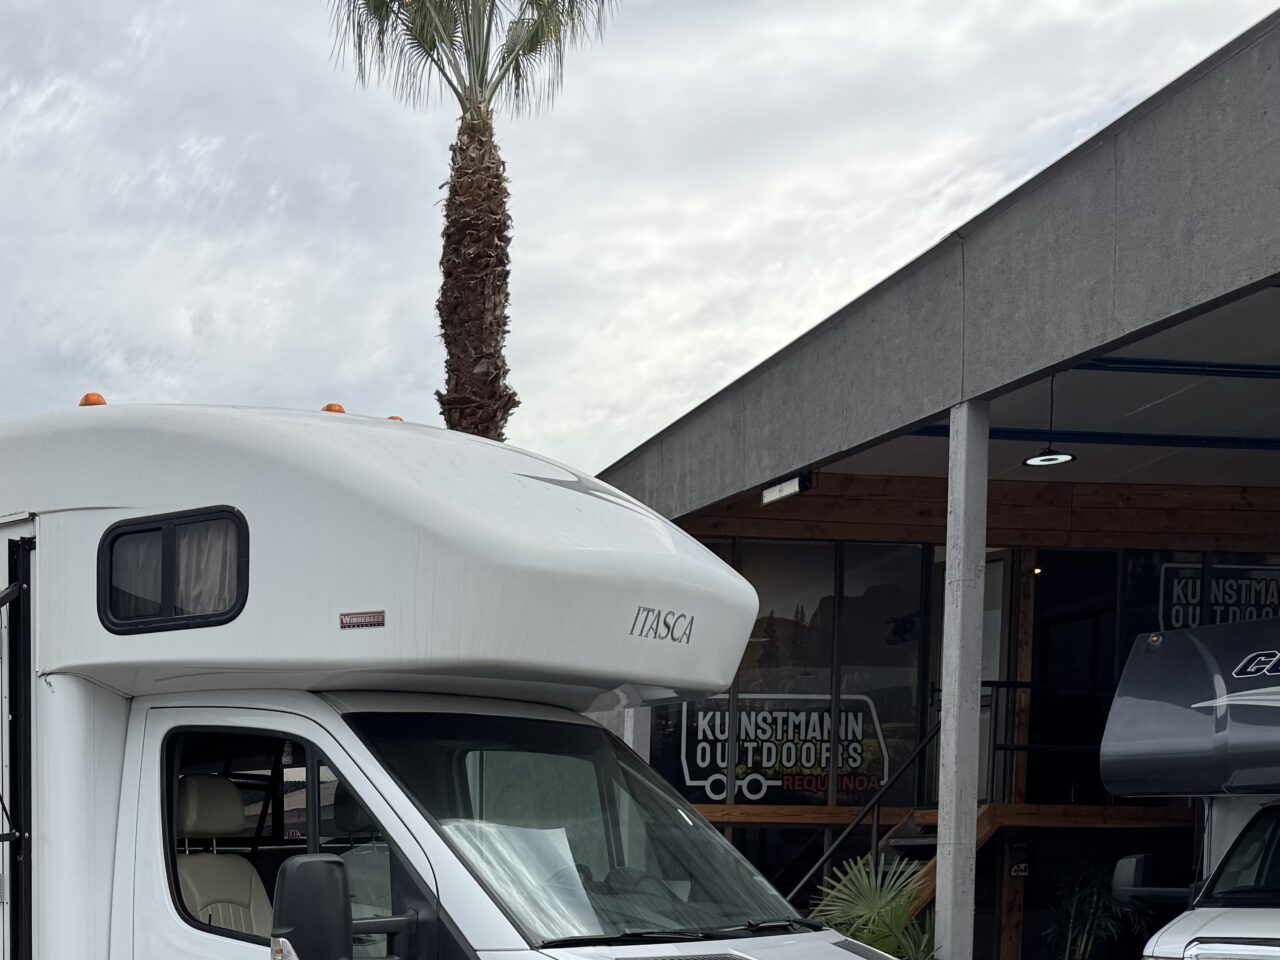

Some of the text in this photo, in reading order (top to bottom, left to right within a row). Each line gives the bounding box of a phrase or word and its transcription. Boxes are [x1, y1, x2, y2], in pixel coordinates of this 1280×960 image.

[1172, 578, 1280, 605] KUNSTMA
[628, 605, 694, 645] ITASCA
[697, 711, 863, 741] KUNSTMANN
[696, 741, 862, 768] OUTDOORS
